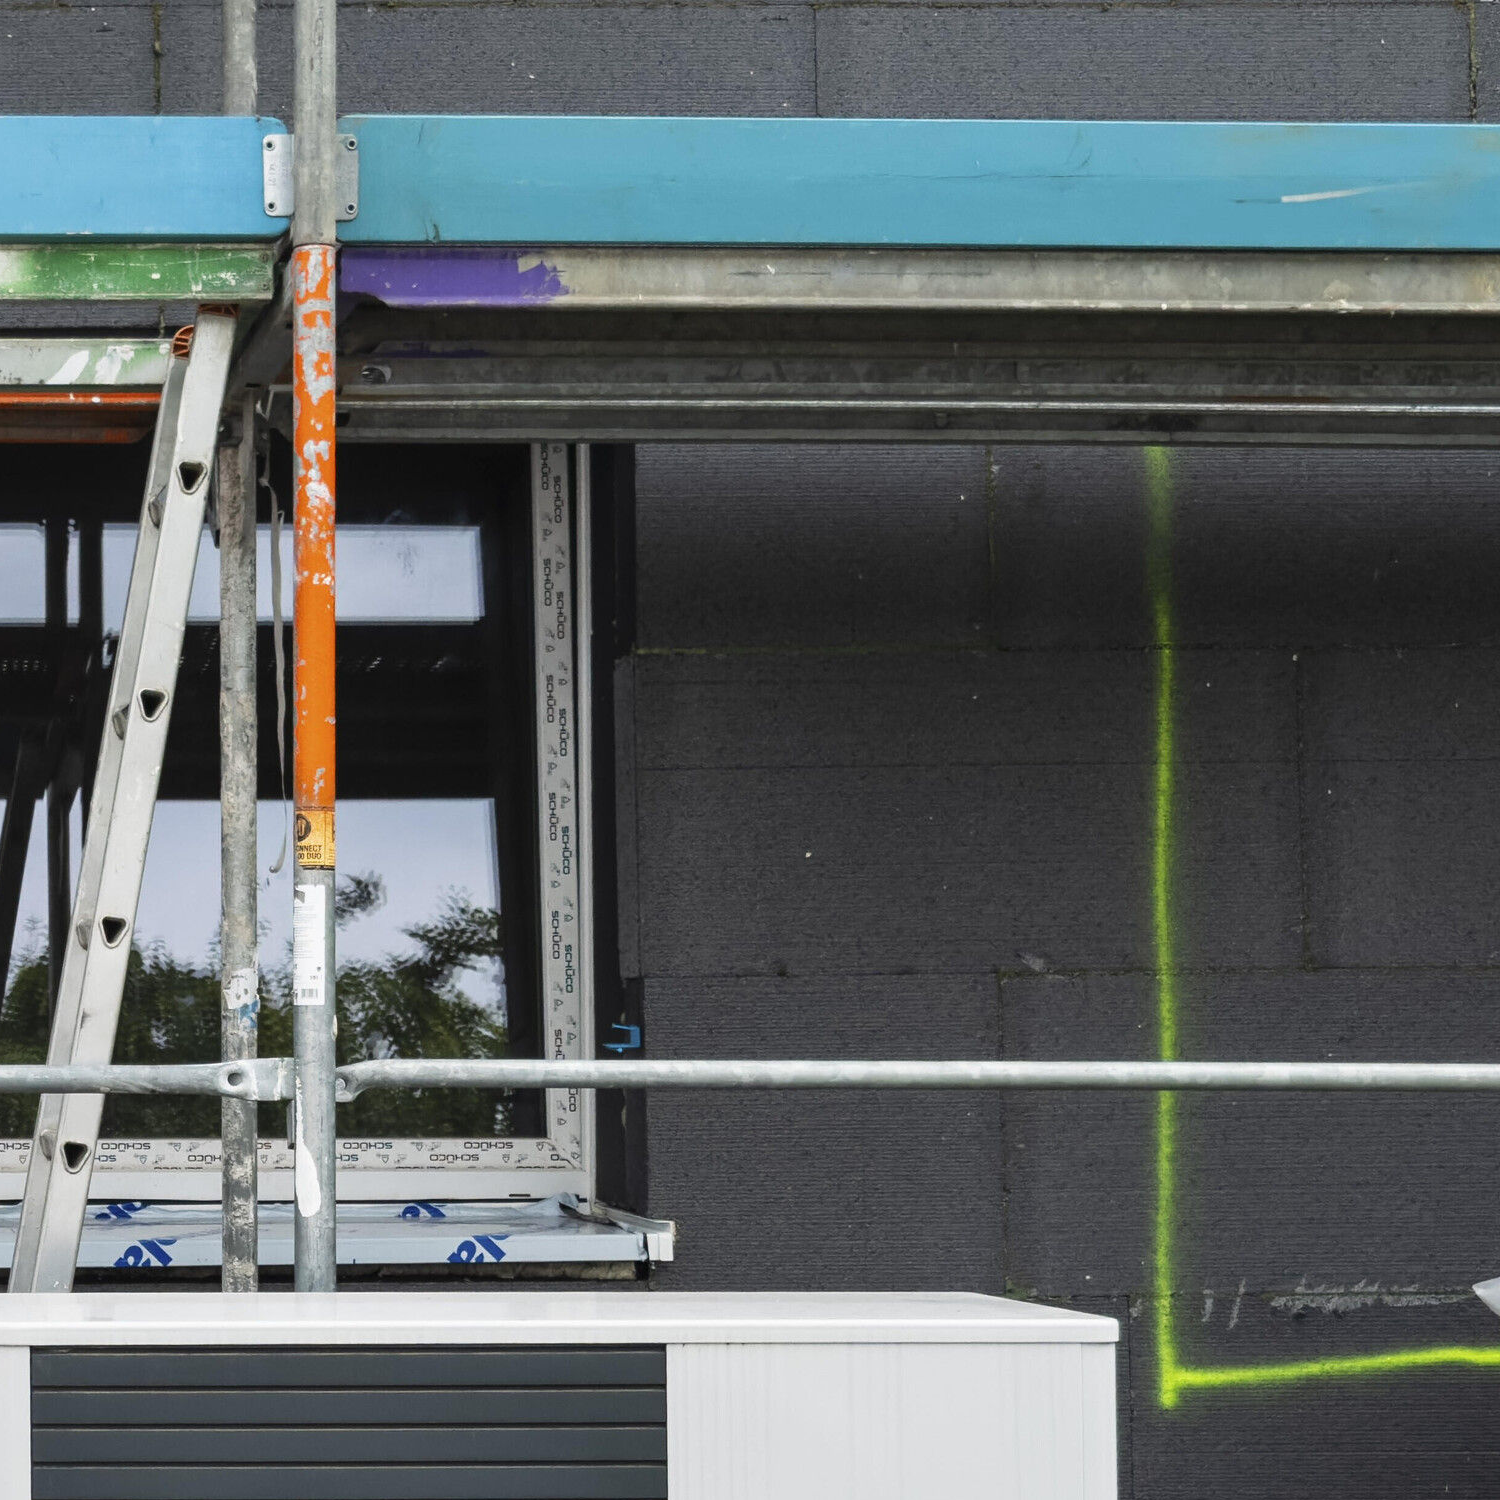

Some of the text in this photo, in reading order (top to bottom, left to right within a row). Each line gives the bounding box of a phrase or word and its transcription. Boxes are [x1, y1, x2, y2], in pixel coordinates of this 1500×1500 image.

[553, 475, 564, 523] SCHÜCO
[543, 558, 554, 606] SCHÜCO
[556, 591, 566, 639] SCHÜCO
[546, 674, 557, 723] SCHÜCO
[558, 708, 570, 757] SCHÜCO
[548, 792, 558, 841] SCHÜCO
[561, 826, 572, 875] SCHÜCO
[551, 910, 561, 960] SCHÜCO
[565, 944, 575, 993] SCHÜCO
[101, 1142, 151, 1152] SCHÜCO
[188, 1154, 222, 1165] HÜCO
[343, 1141, 393, 1151] SCHÜCO
[430, 1153, 480, 1163] SCHÜCO
[464, 1141, 514, 1151] SCHÜCO
